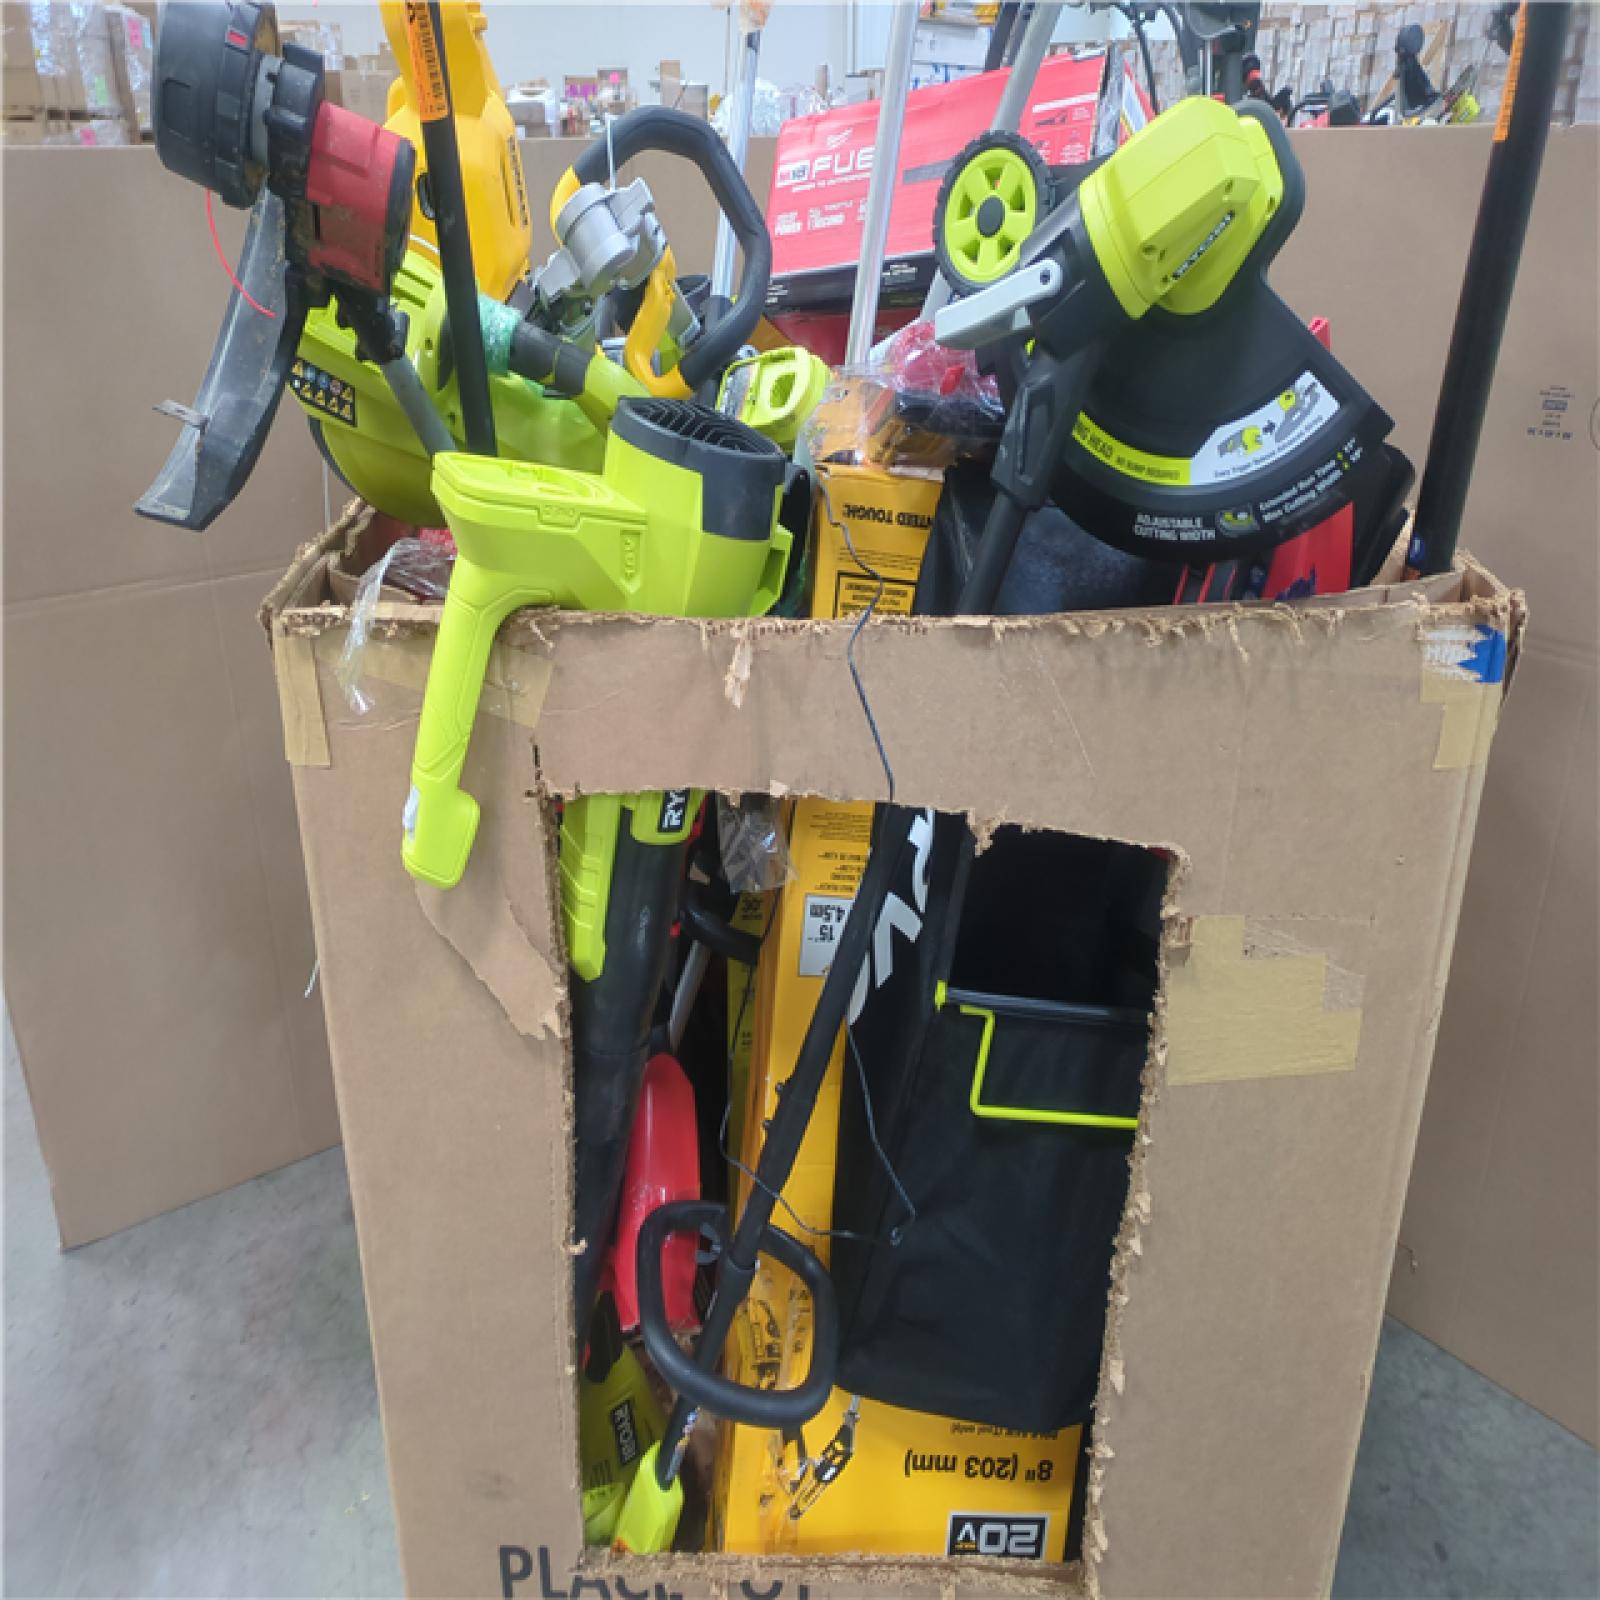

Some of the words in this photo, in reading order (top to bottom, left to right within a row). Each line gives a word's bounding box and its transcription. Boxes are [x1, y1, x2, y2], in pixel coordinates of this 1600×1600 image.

[811, 145, 877, 180] FUE
[904, 1448, 957, 1478] mm)
[964, 1452, 1018, 1481] (203
[1024, 1459, 1053, 1481] 8"
